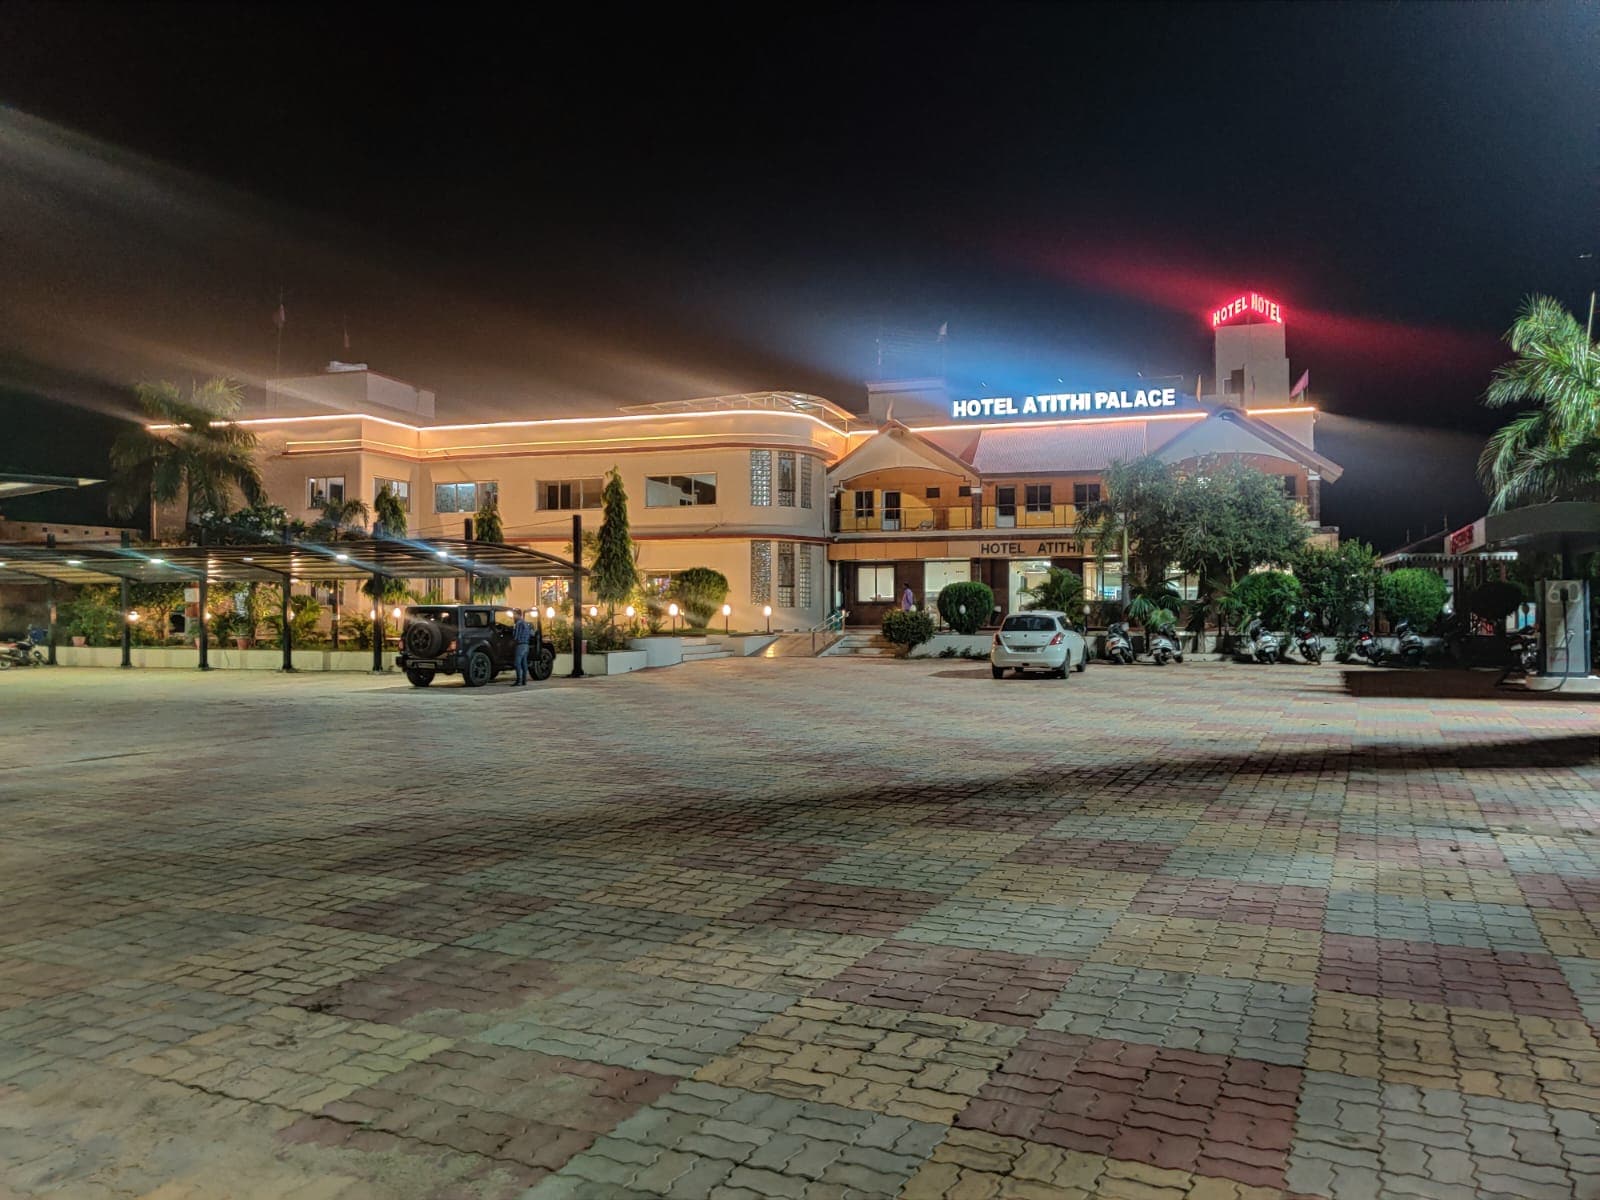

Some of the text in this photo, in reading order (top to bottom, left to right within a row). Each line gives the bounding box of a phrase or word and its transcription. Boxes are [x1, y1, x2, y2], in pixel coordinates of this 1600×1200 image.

[1212, 296, 1248, 327] HOTEL
[1250, 292, 1282, 324] HOTEL
[952, 388, 1176, 417] HOTEL ATITHI PALACE
[980, 542, 1025, 554] HOTEL
